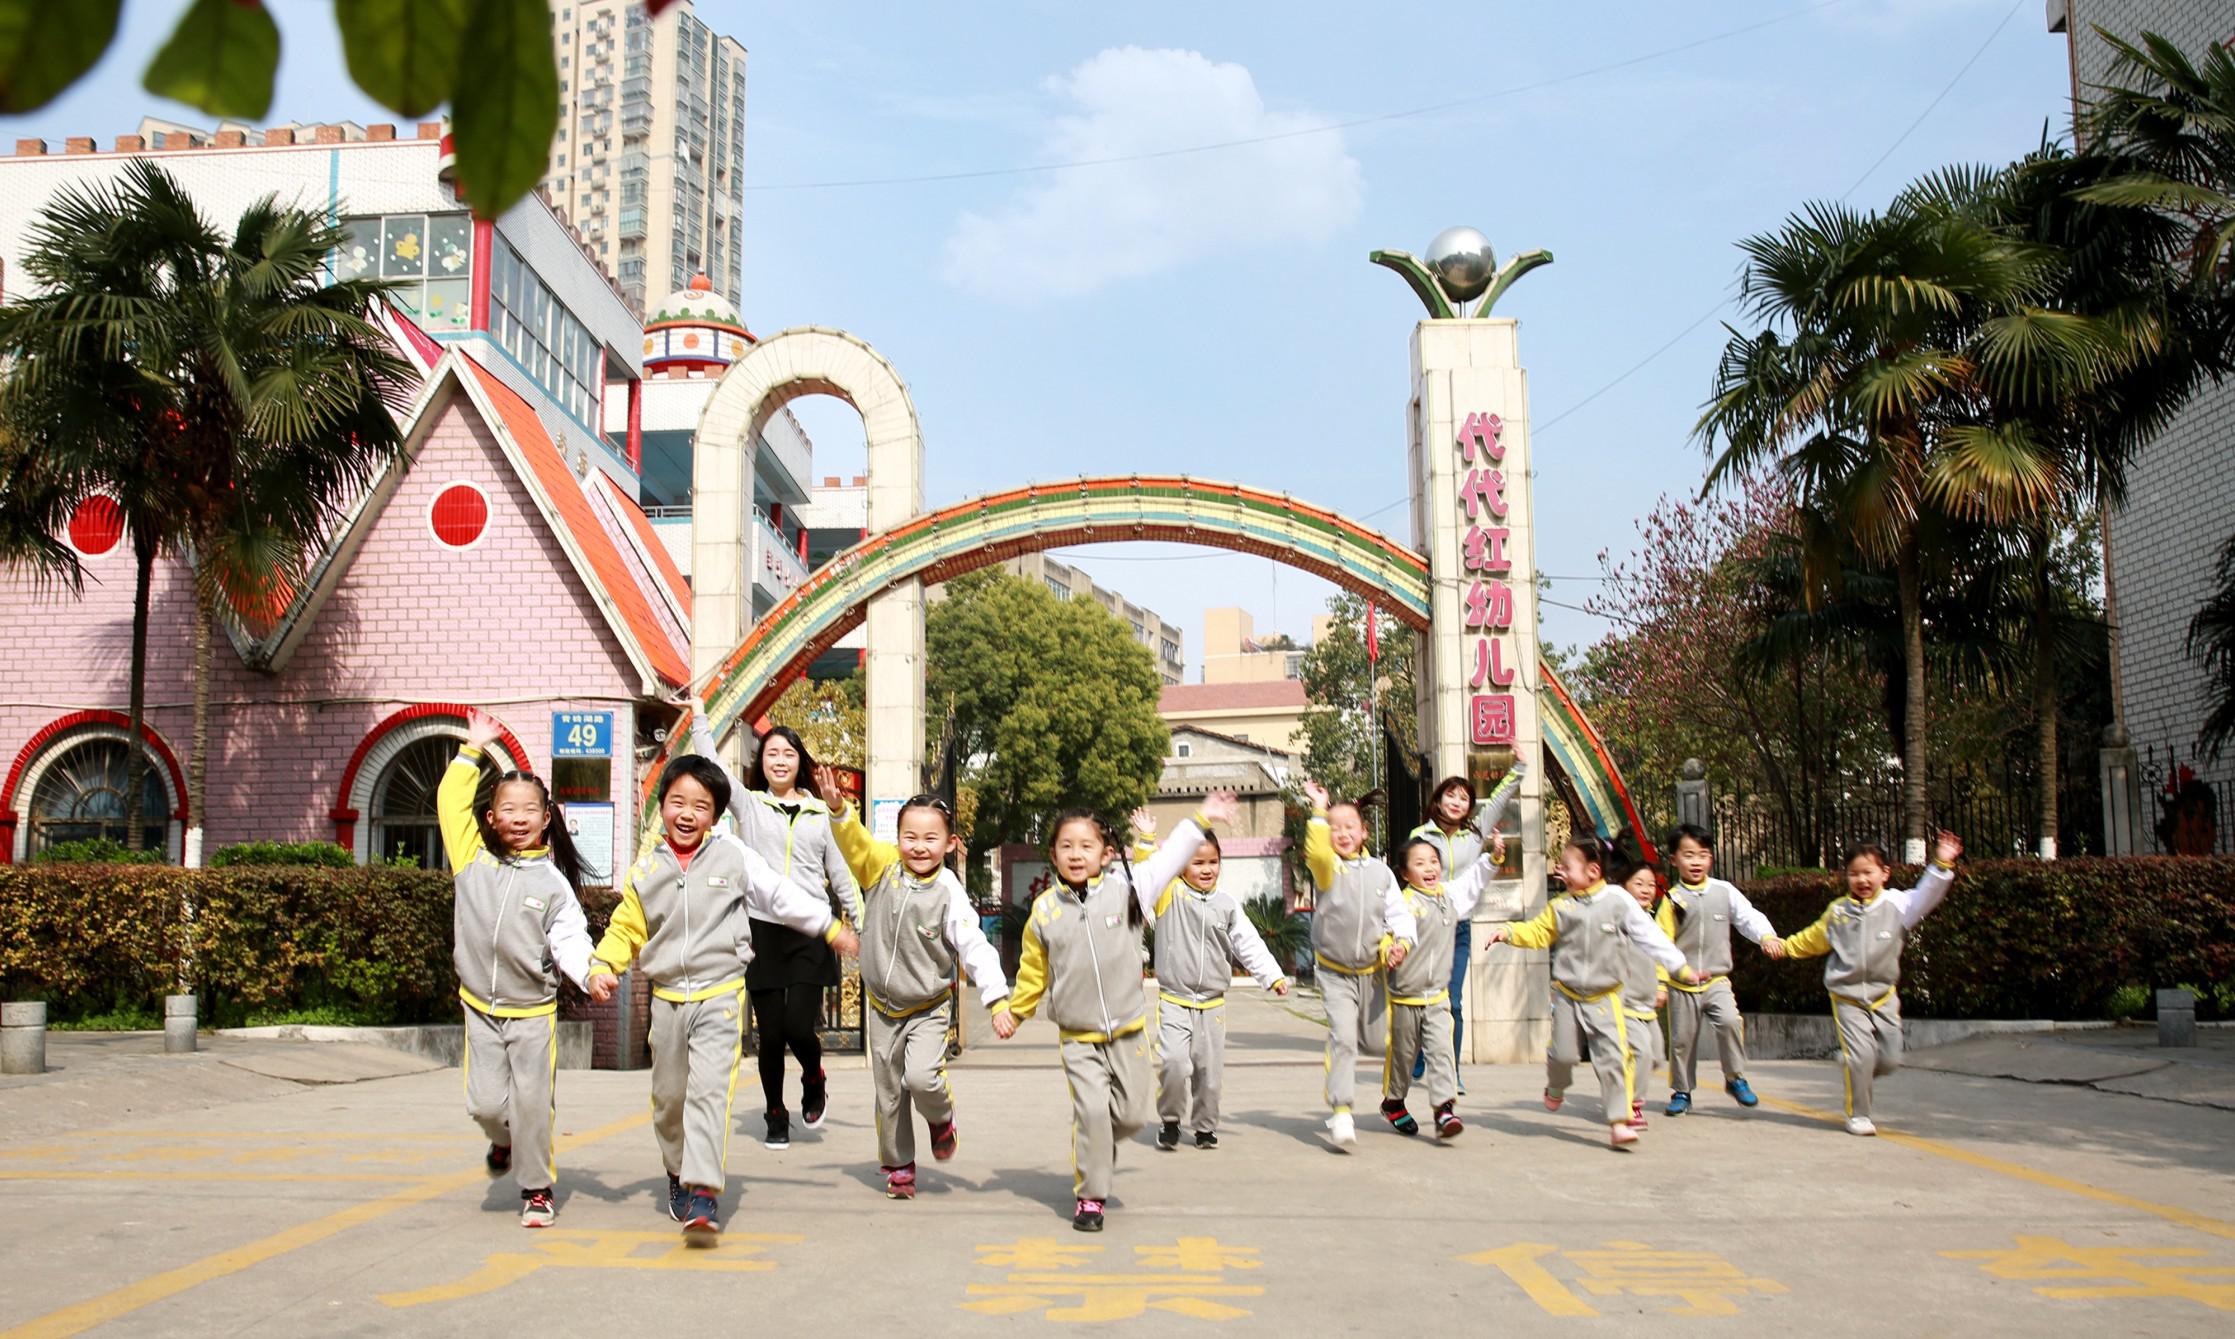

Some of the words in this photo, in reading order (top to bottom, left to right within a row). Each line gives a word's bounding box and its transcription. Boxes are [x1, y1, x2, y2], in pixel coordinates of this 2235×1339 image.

[1458, 411, 1516, 745] 代代红幼儿园
[568, 724, 597, 747] 49
